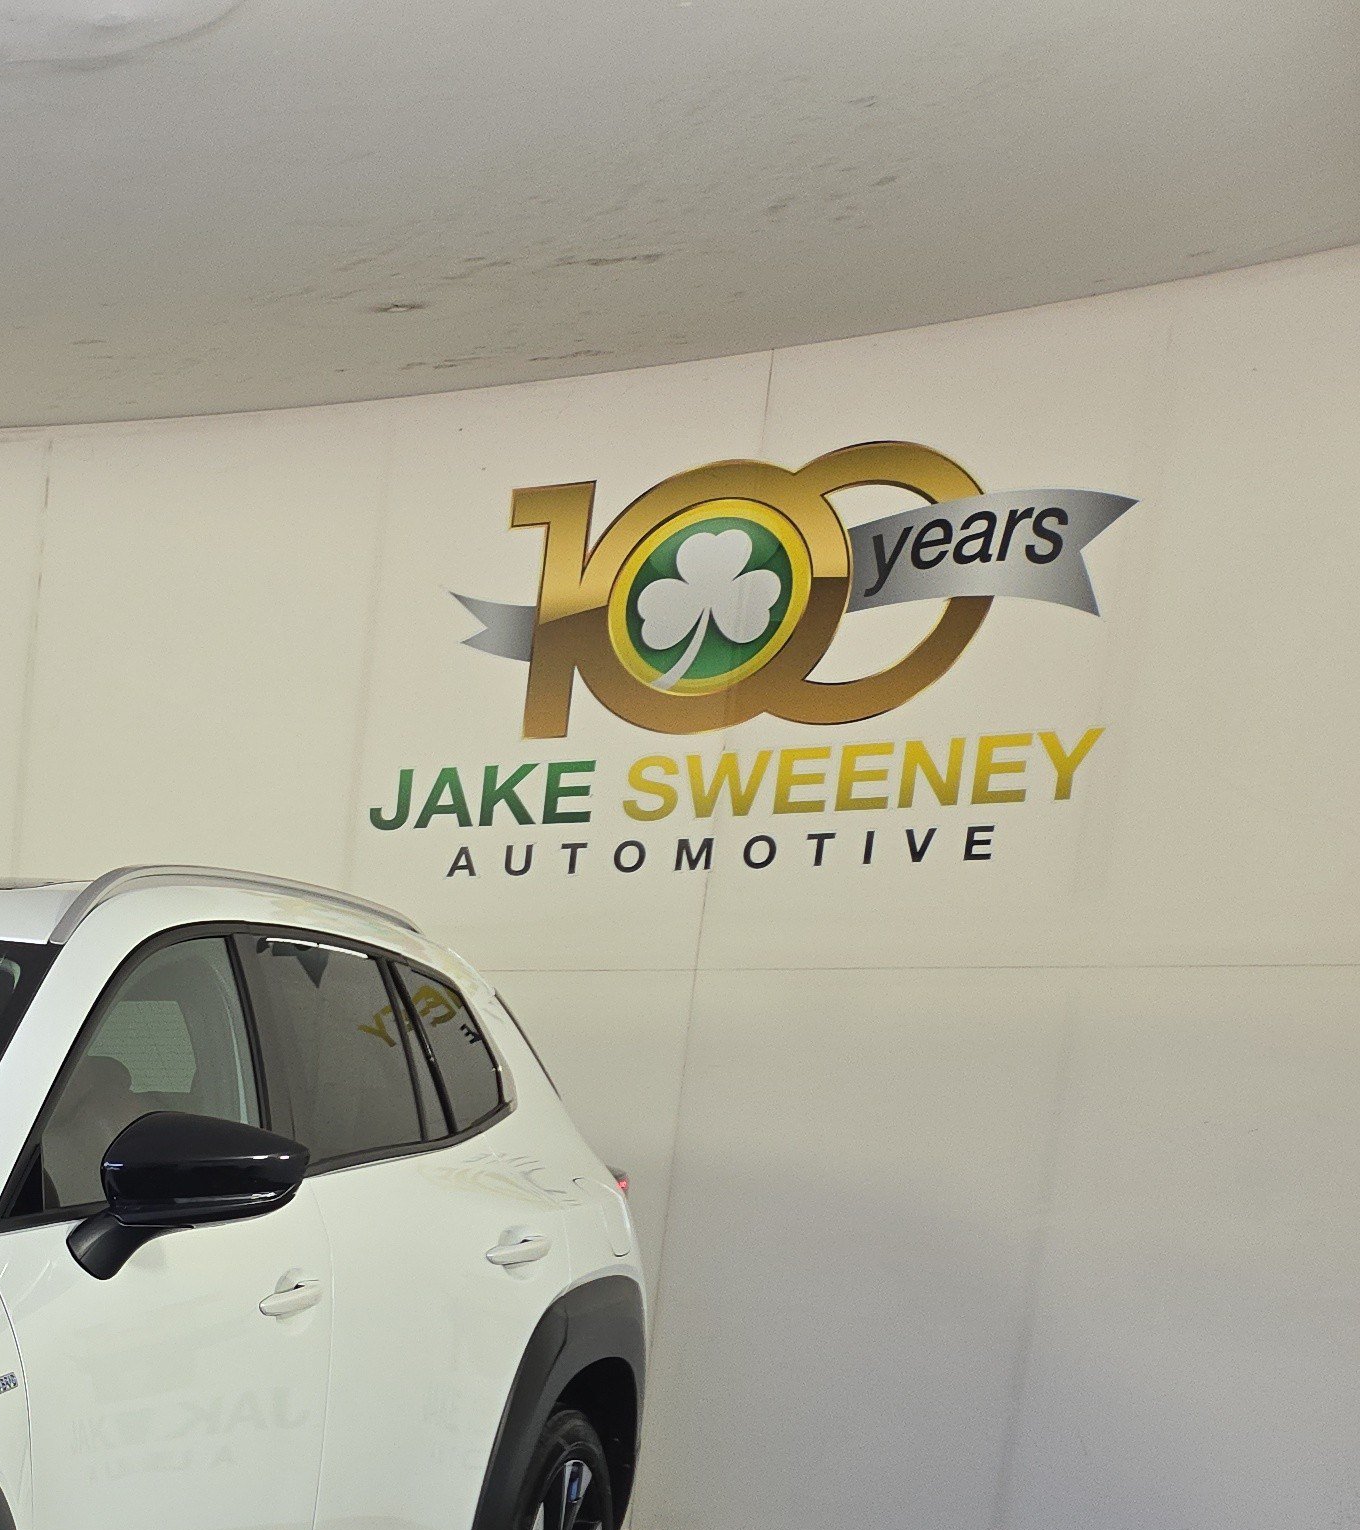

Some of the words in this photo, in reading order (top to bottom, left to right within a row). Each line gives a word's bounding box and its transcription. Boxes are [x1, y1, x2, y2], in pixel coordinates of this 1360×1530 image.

[864, 505, 1068, 598] years
[368, 759, 597, 832] JAKE
[622, 727, 1106, 823] SWEENEY
[447, 825, 995, 878] AUTOMOTIVE
